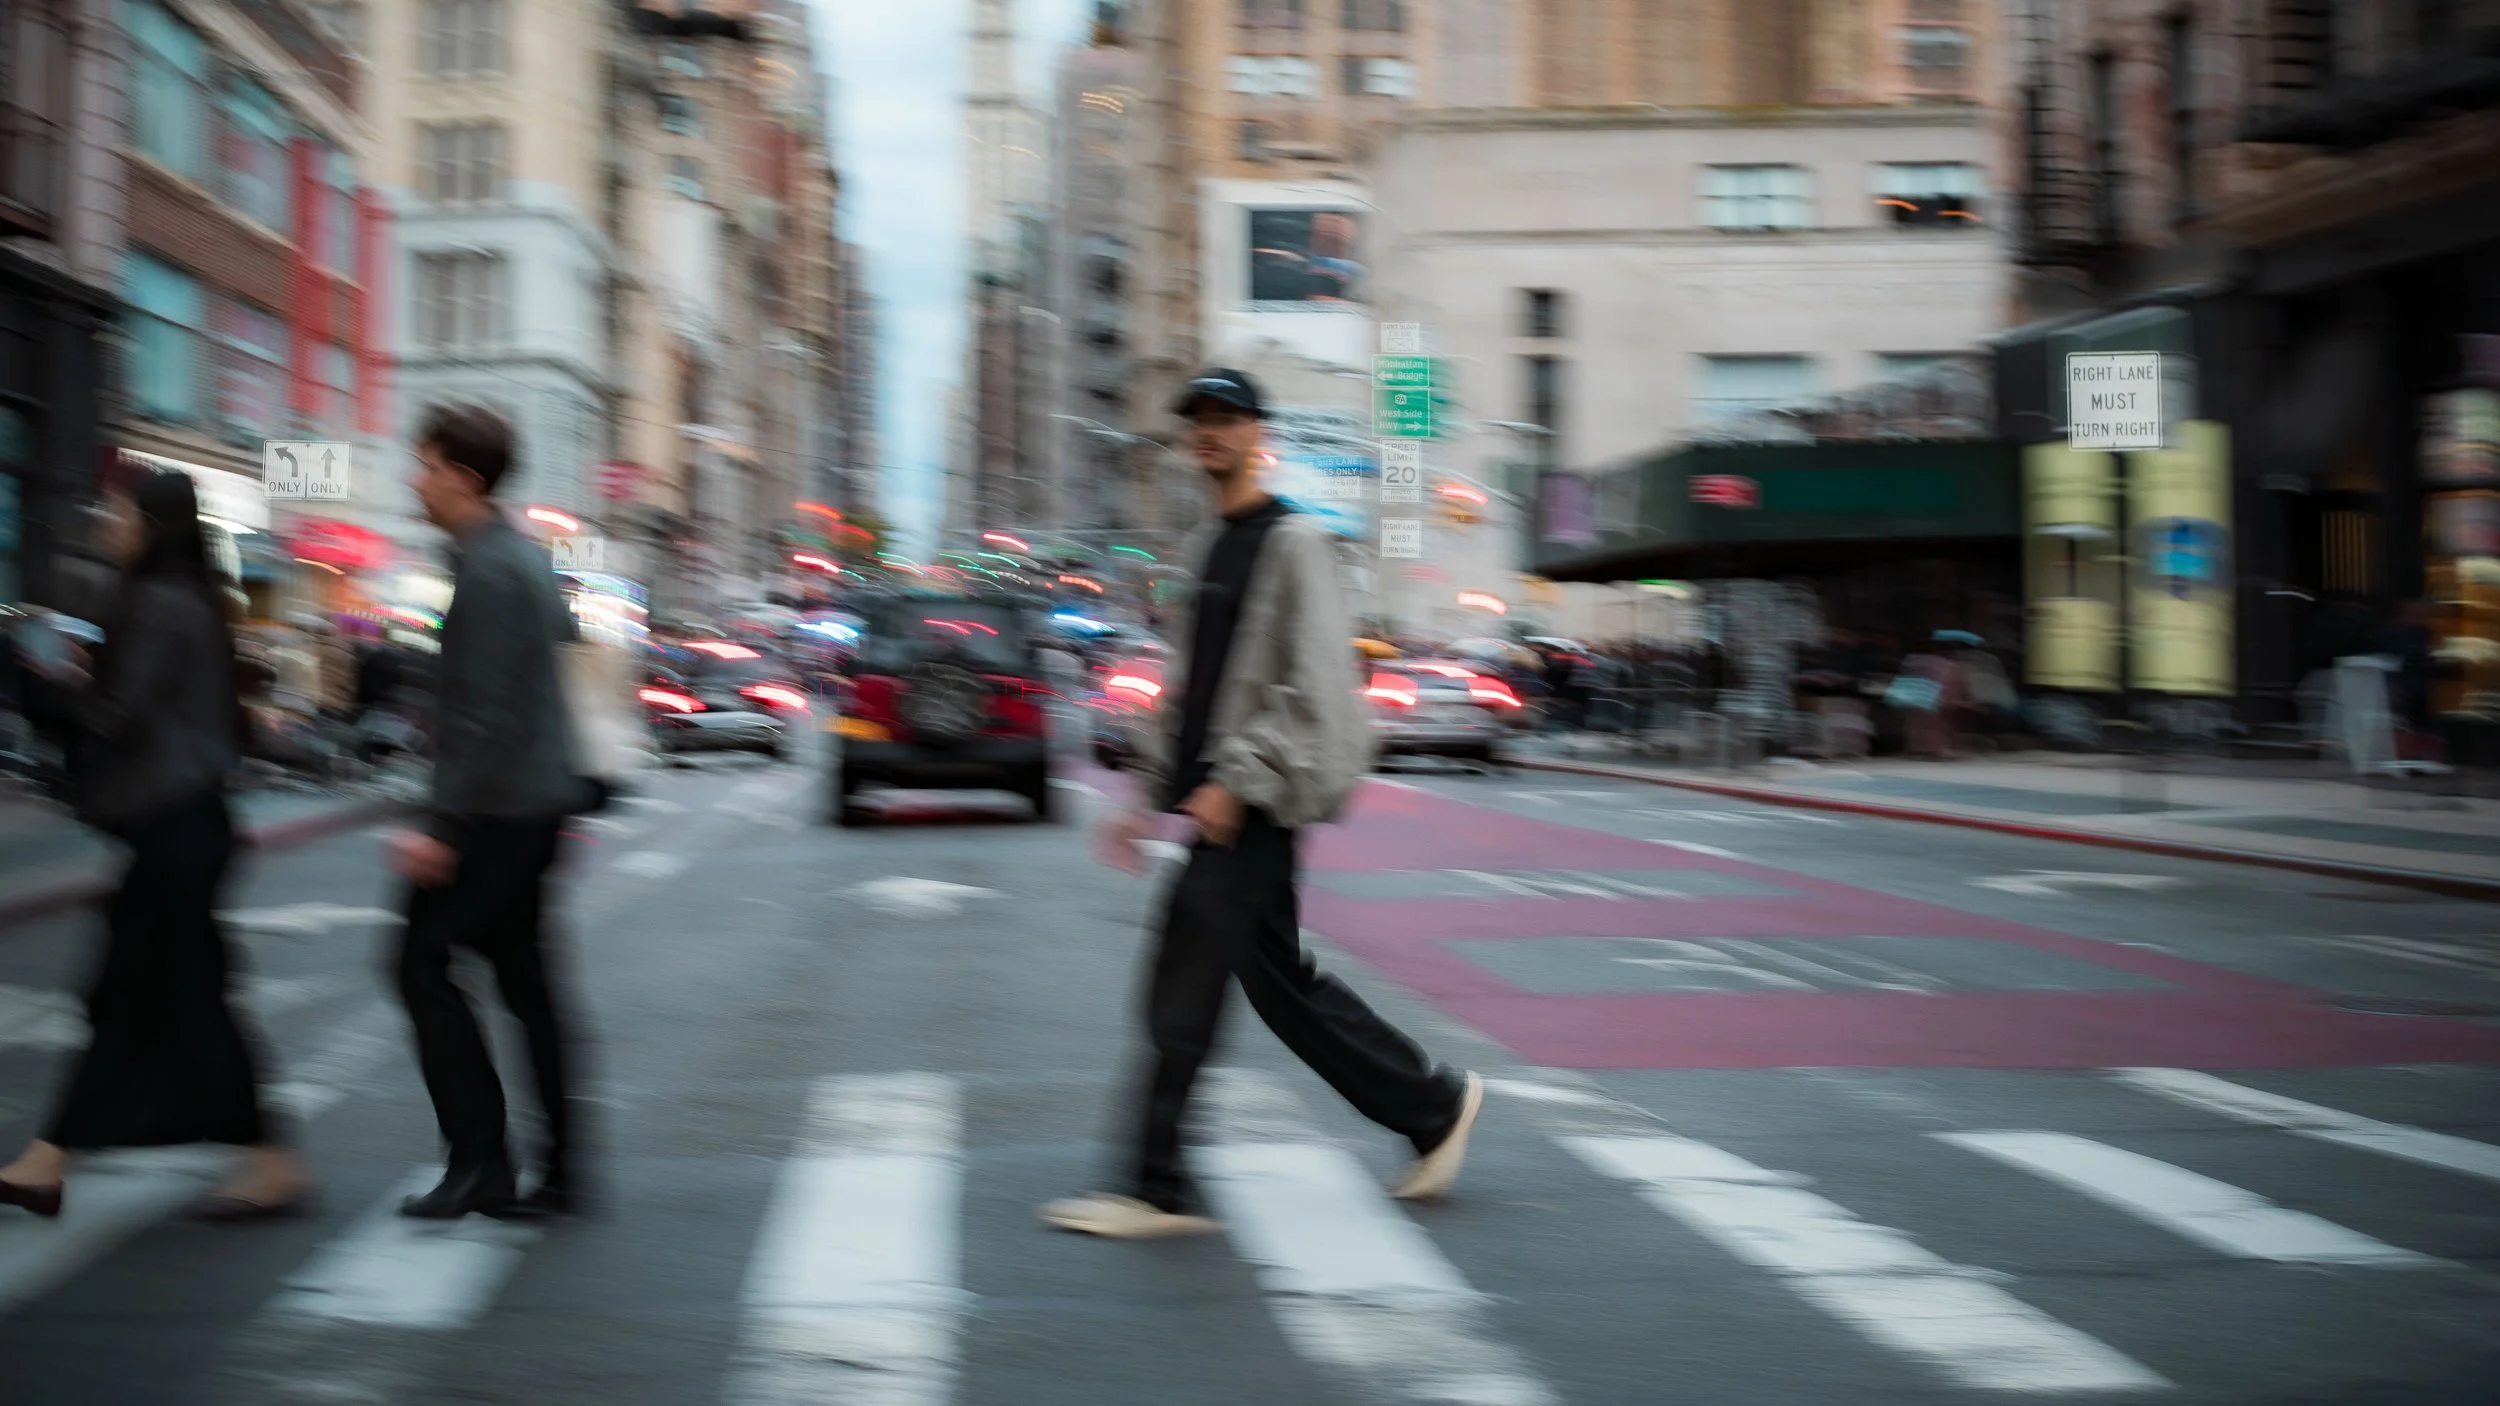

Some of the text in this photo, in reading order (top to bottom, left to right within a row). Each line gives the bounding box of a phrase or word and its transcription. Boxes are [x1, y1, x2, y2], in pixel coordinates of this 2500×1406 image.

[1379, 360, 1423, 368] Manhattan
[1397, 371, 1424, 381] Bridge
[2073, 365, 2154, 381] RIGHT LANE
[1396, 395, 1405, 403] 9A
[2091, 392, 2136, 411] MUST
[1380, 409, 1423, 418] West Side
[2074, 422, 2155, 437] TURN RIGHT
[1384, 442, 1417, 451] SPEED
[1336, 467, 1358, 475] ONLY
[1386, 466, 1416, 484] 20
[269, 481, 343, 494] ONLY ONLY
[1390, 534, 1411, 543] MUST
